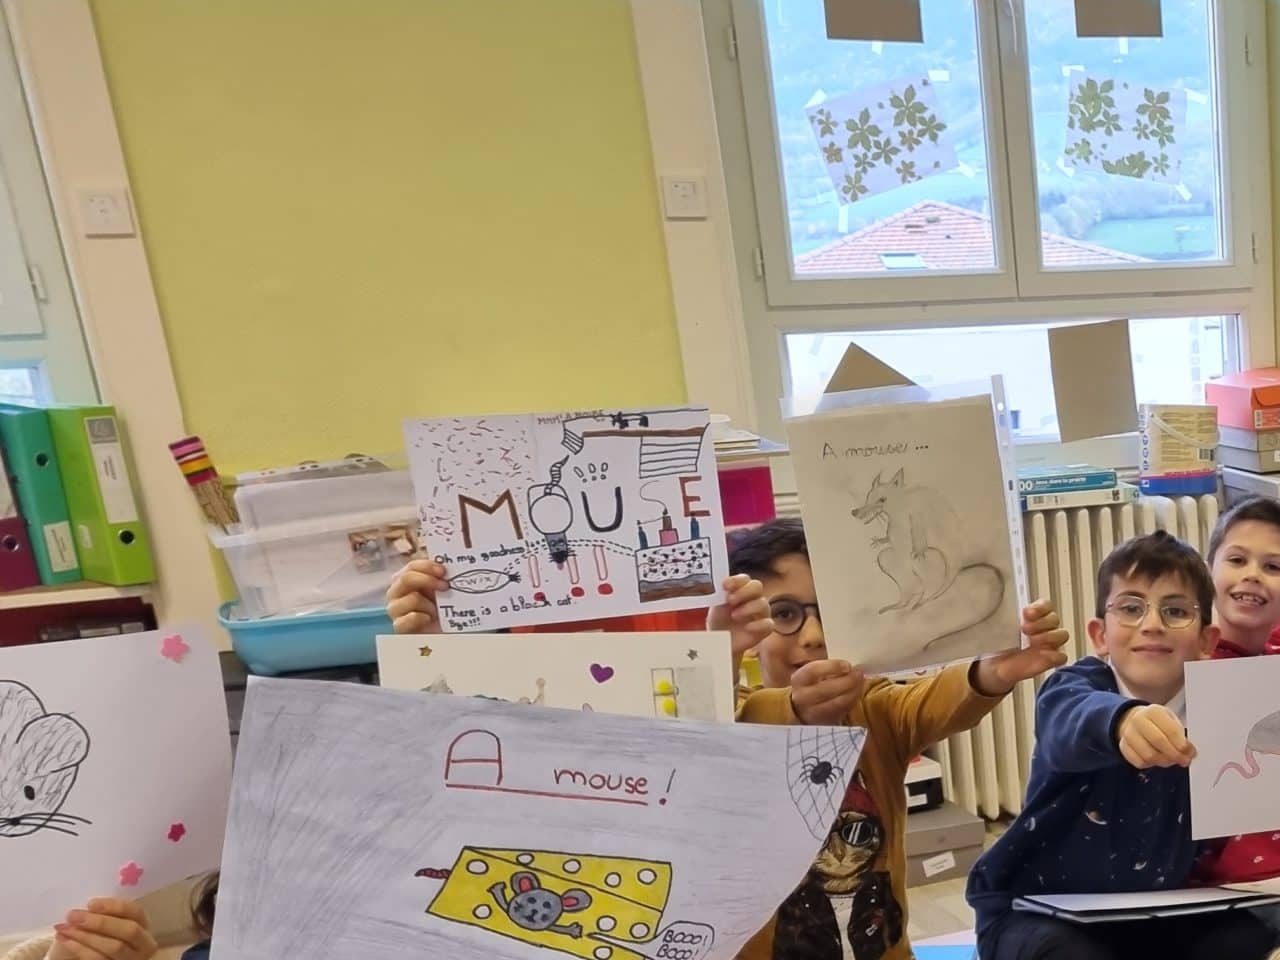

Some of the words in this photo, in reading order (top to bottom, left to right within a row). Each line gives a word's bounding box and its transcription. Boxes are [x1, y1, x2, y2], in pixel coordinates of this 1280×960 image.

[822, 441, 838, 460] A
[434, 553, 454, 565] Oh
[457, 552, 477, 563] my
[439, 605, 477, 619] There
[480, 606, 491, 616] is
[500, 604, 509, 613] a
[511, 597, 552, 612] black
[444, 729, 503, 786] A
